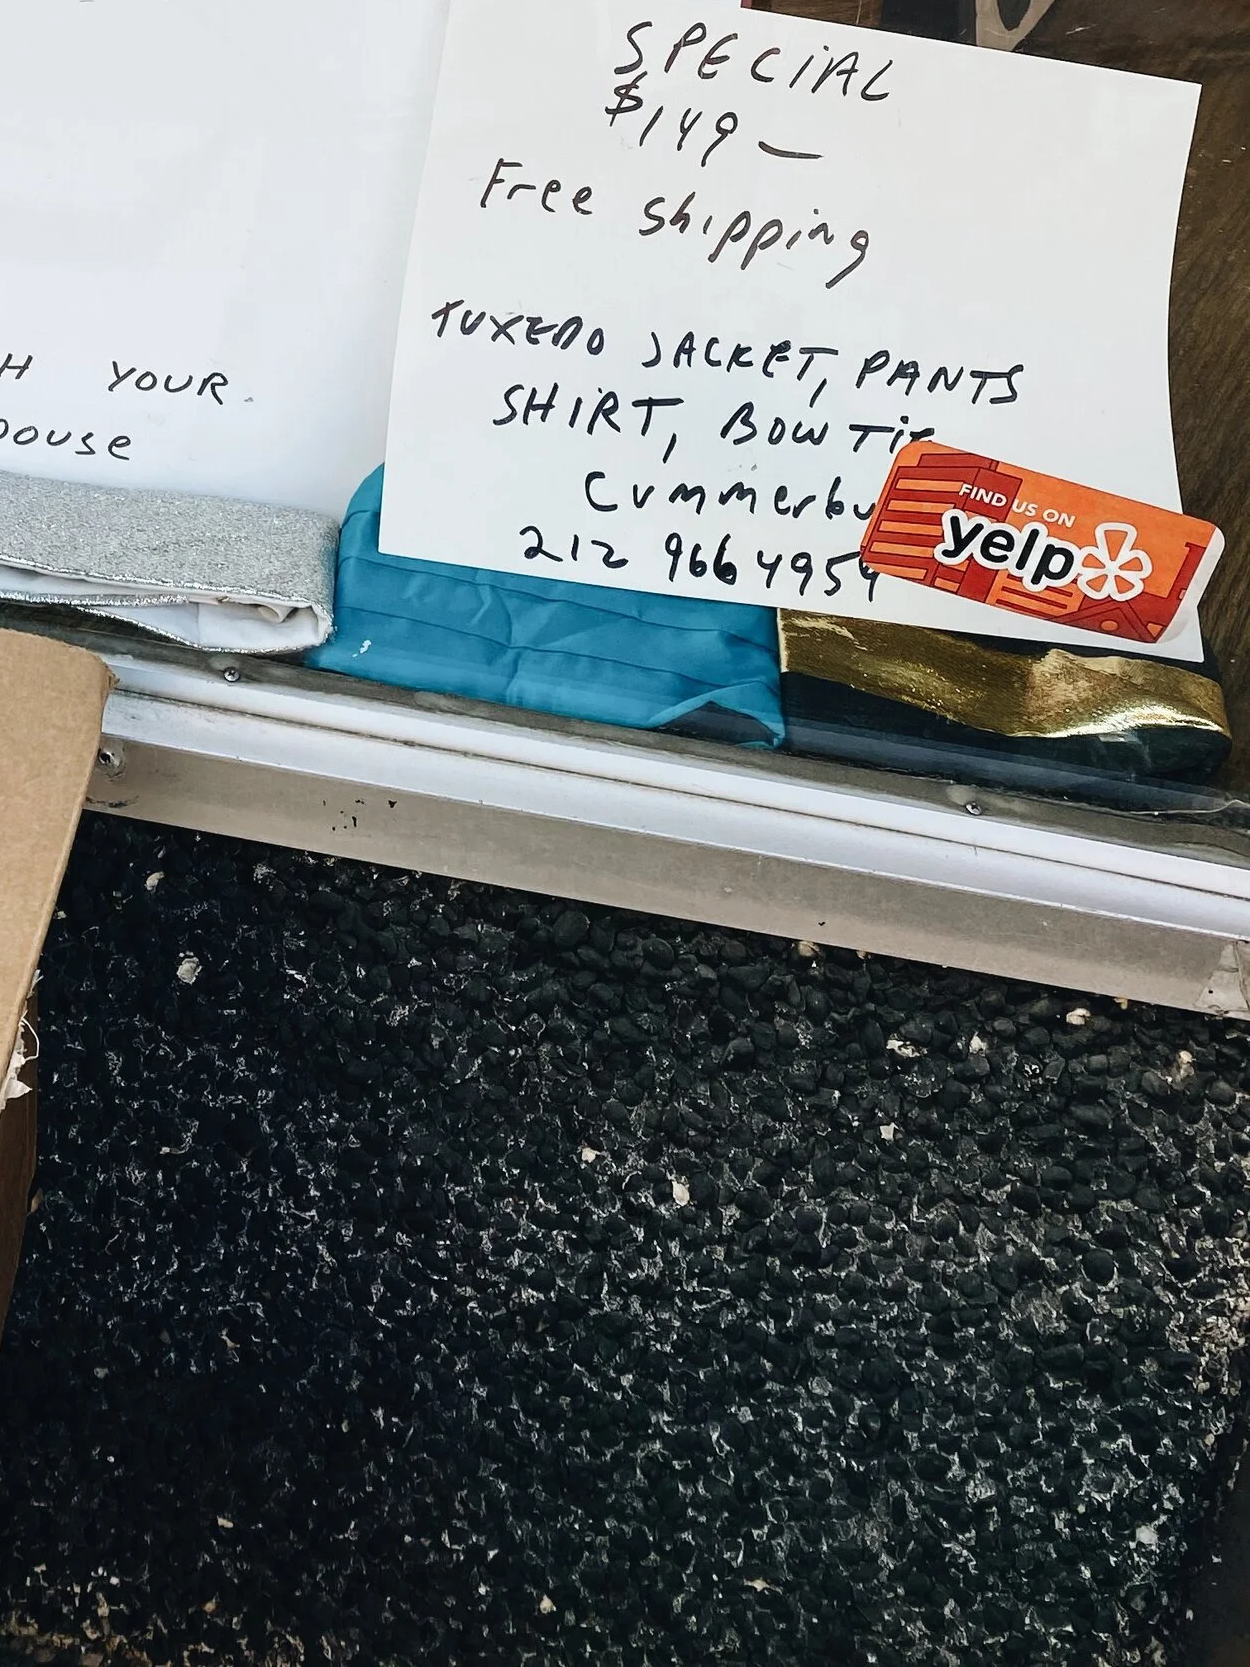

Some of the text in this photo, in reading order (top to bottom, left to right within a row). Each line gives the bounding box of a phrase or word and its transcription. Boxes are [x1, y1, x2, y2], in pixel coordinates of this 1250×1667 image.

[605, 71, 739, 166] $149
[480, 158, 593, 216] Free
[431, 299, 1025, 407] TUXEDO JACKET, PANTS
[721, 402, 830, 446] BOW
[584, 471, 877, 524] Cummerbu
[958, 483, 1077, 529] FIND US ON
[519, 525, 629, 569] 212
[665, 533, 738, 588] 966
[941, 515, 1075, 585] yelp
